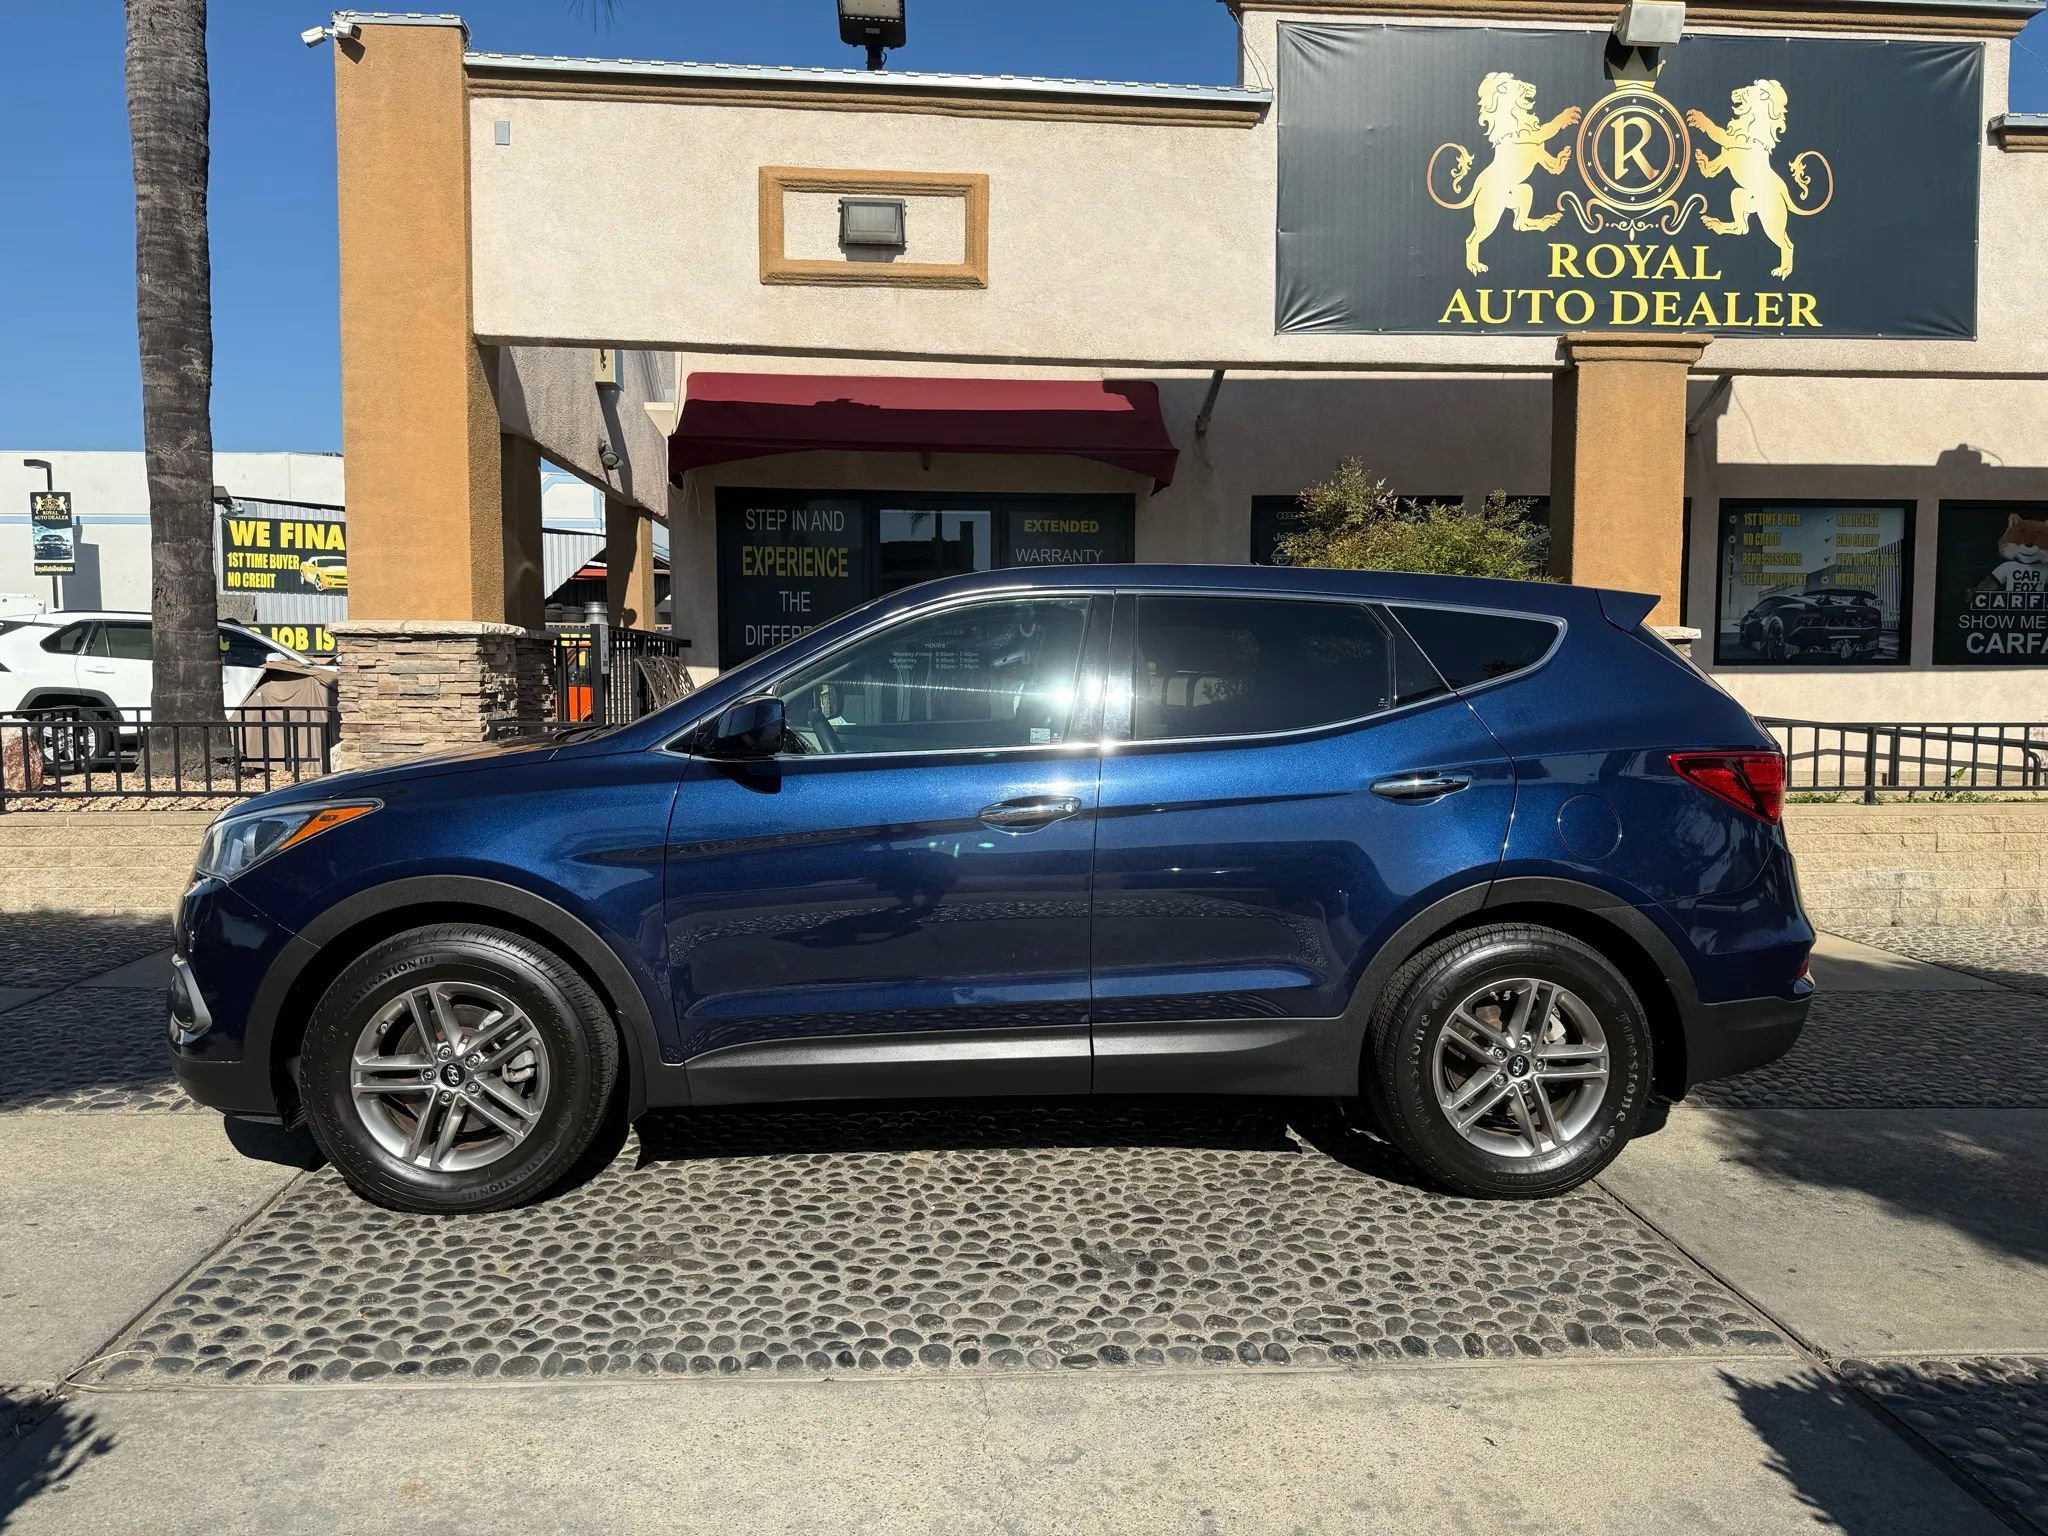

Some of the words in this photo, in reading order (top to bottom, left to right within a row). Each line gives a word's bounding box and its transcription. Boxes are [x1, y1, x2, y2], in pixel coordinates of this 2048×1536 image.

[1611, 115, 1660, 181] R
[1547, 243, 1721, 280] ROYAL
[1438, 288, 1595, 325] AUTO
[1609, 290, 1823, 327] DEALER
[745, 508, 787, 531] STEP
[792, 509, 807, 531] IN
[811, 510, 845, 532] AND
[1023, 519, 1100, 533] EXTENDED
[1743, 512, 1757, 526] 1ST
[1759, 512, 1776, 526] TIME
[229, 520, 270, 547] WE
[280, 522, 346, 551] FINA
[1743, 532, 1754, 546] NO
[227, 552, 244, 568] 1ST
[245, 553, 268, 568] TIME
[269, 554, 300, 570] BUYER
[742, 545, 849, 578] EXPERIENCE
[1015, 548, 1103, 563] WARRANTY
[227, 572, 241, 587] NO
[242, 572, 276, 588] CREDIT
[2013, 570, 2040, 581] CAR
[2014, 582, 2039, 592] FOX
[779, 591, 811, 612] THE
[1975, 594, 2048, 608] CARF
[1958, 615, 2015, 628] SHOW
[2020, 615, 2047, 629] ME
[315, 627, 336, 651] IS
